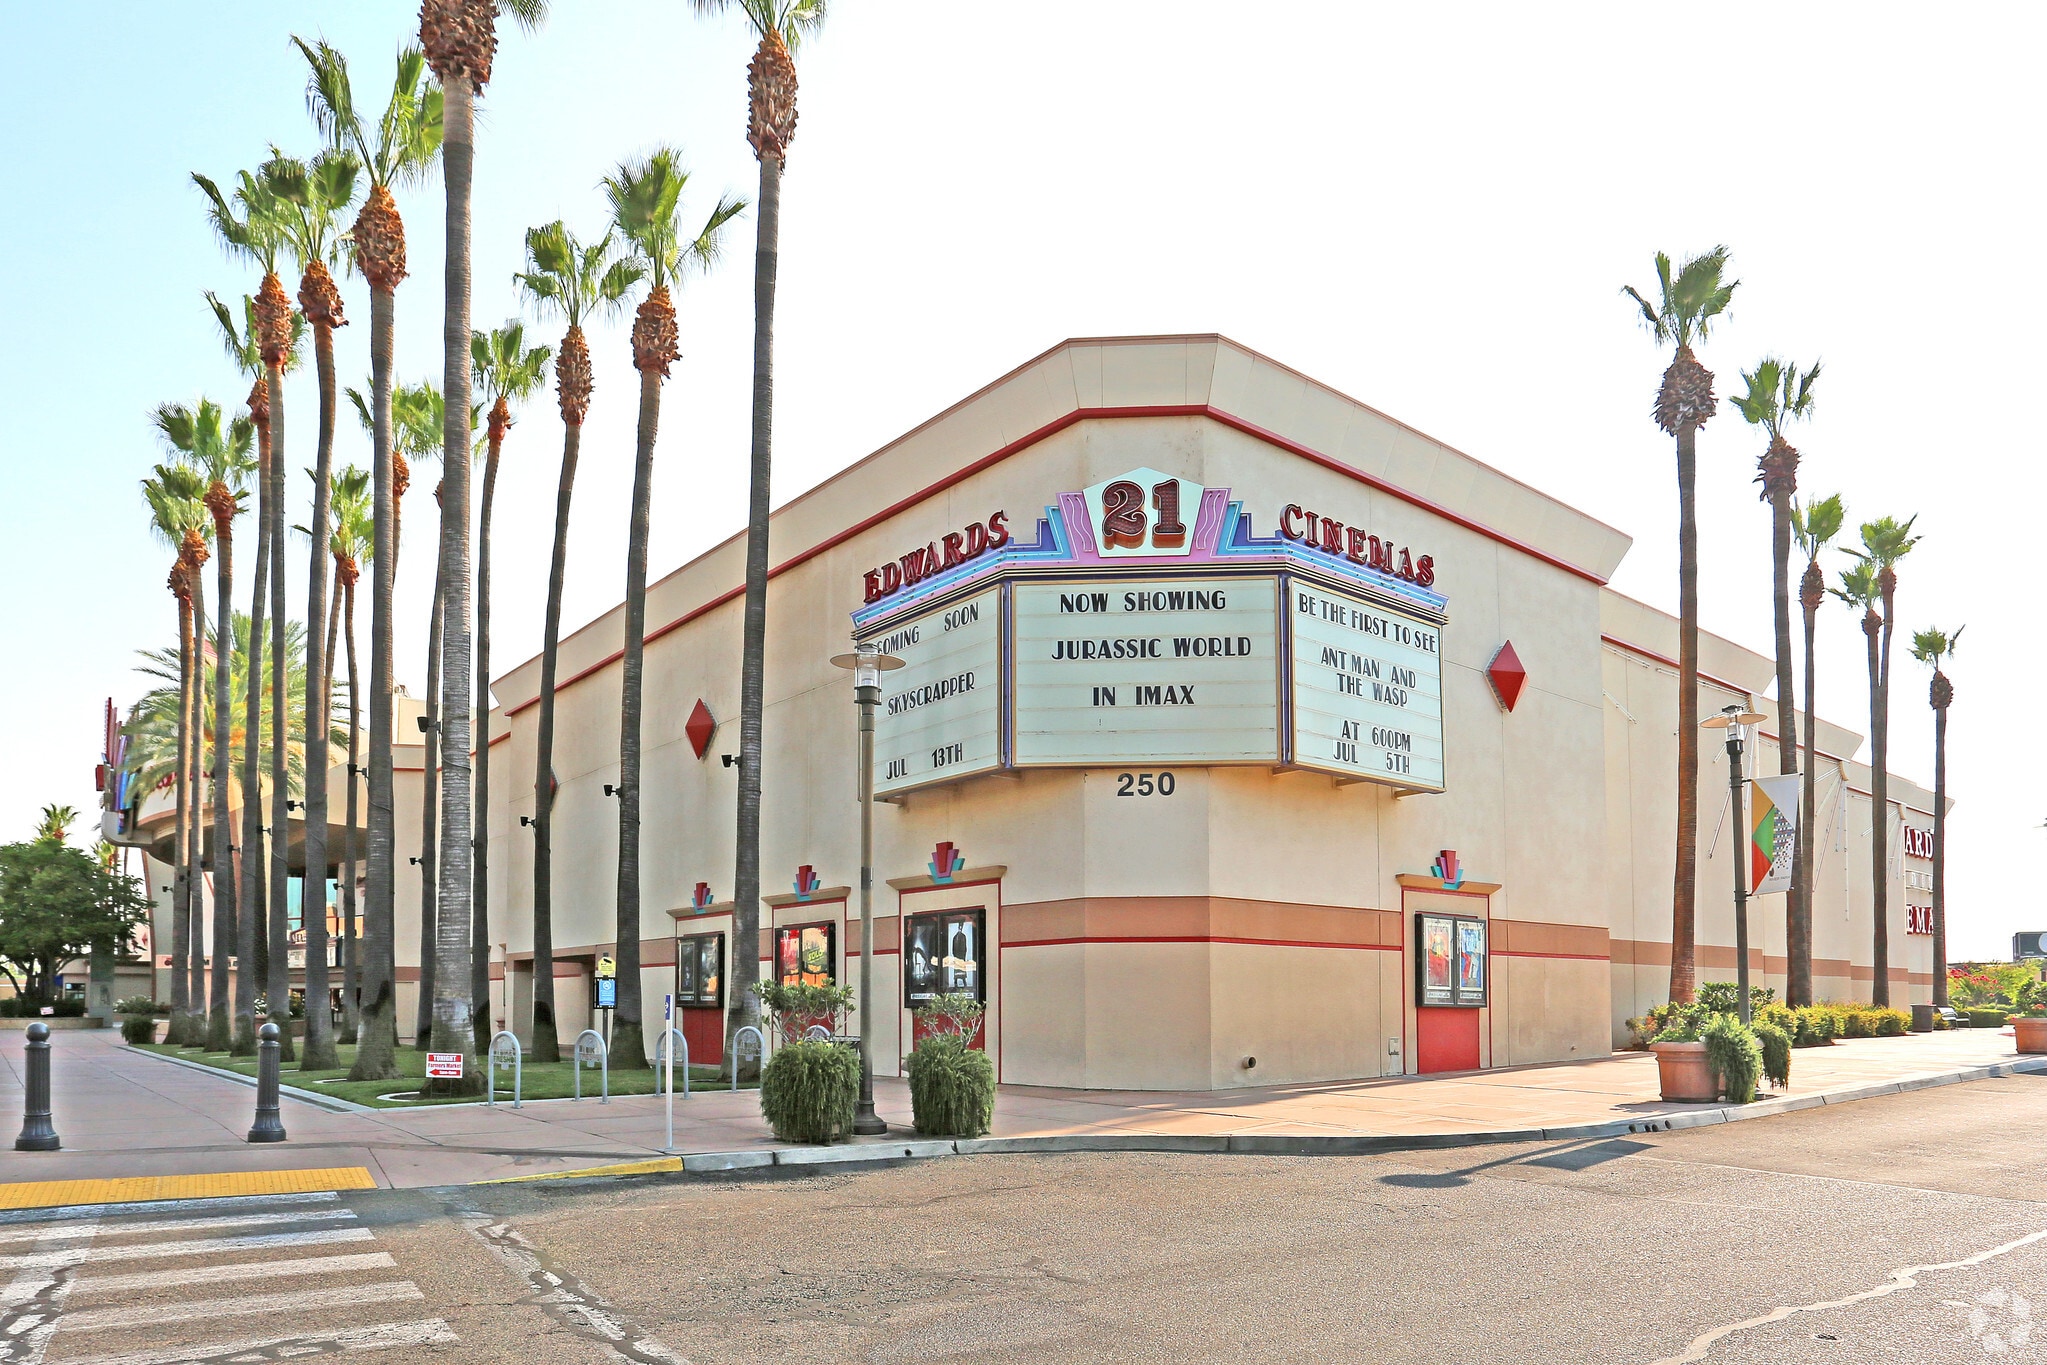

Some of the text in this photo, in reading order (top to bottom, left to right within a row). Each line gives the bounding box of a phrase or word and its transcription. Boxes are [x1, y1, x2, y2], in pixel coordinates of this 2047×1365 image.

[863, 478, 1435, 604] EDWARDS 21 CINEMAS
[944, 602, 979, 632] SOON
[1060, 590, 1226, 613] NOW SHOWING
[1299, 592, 1436, 653] BE THE FIRST TO SEE
[1051, 637, 1251, 660] JURASSIC WORLD
[1321, 646, 1416, 689] ANT MAN AND
[888, 671, 975, 716] SKYSCRAPPER
[1092, 685, 1195, 706] IN IMAX
[1337, 673, 1408, 707] THE WASP
[1341, 720, 1411, 752] AT 600PM
[886, 742, 964, 780] JUL 13TH
[1333, 741, 1410, 774] JUL 5TH
[1117, 772, 1176, 797] 250
[808, 951, 823, 960] SOLO
